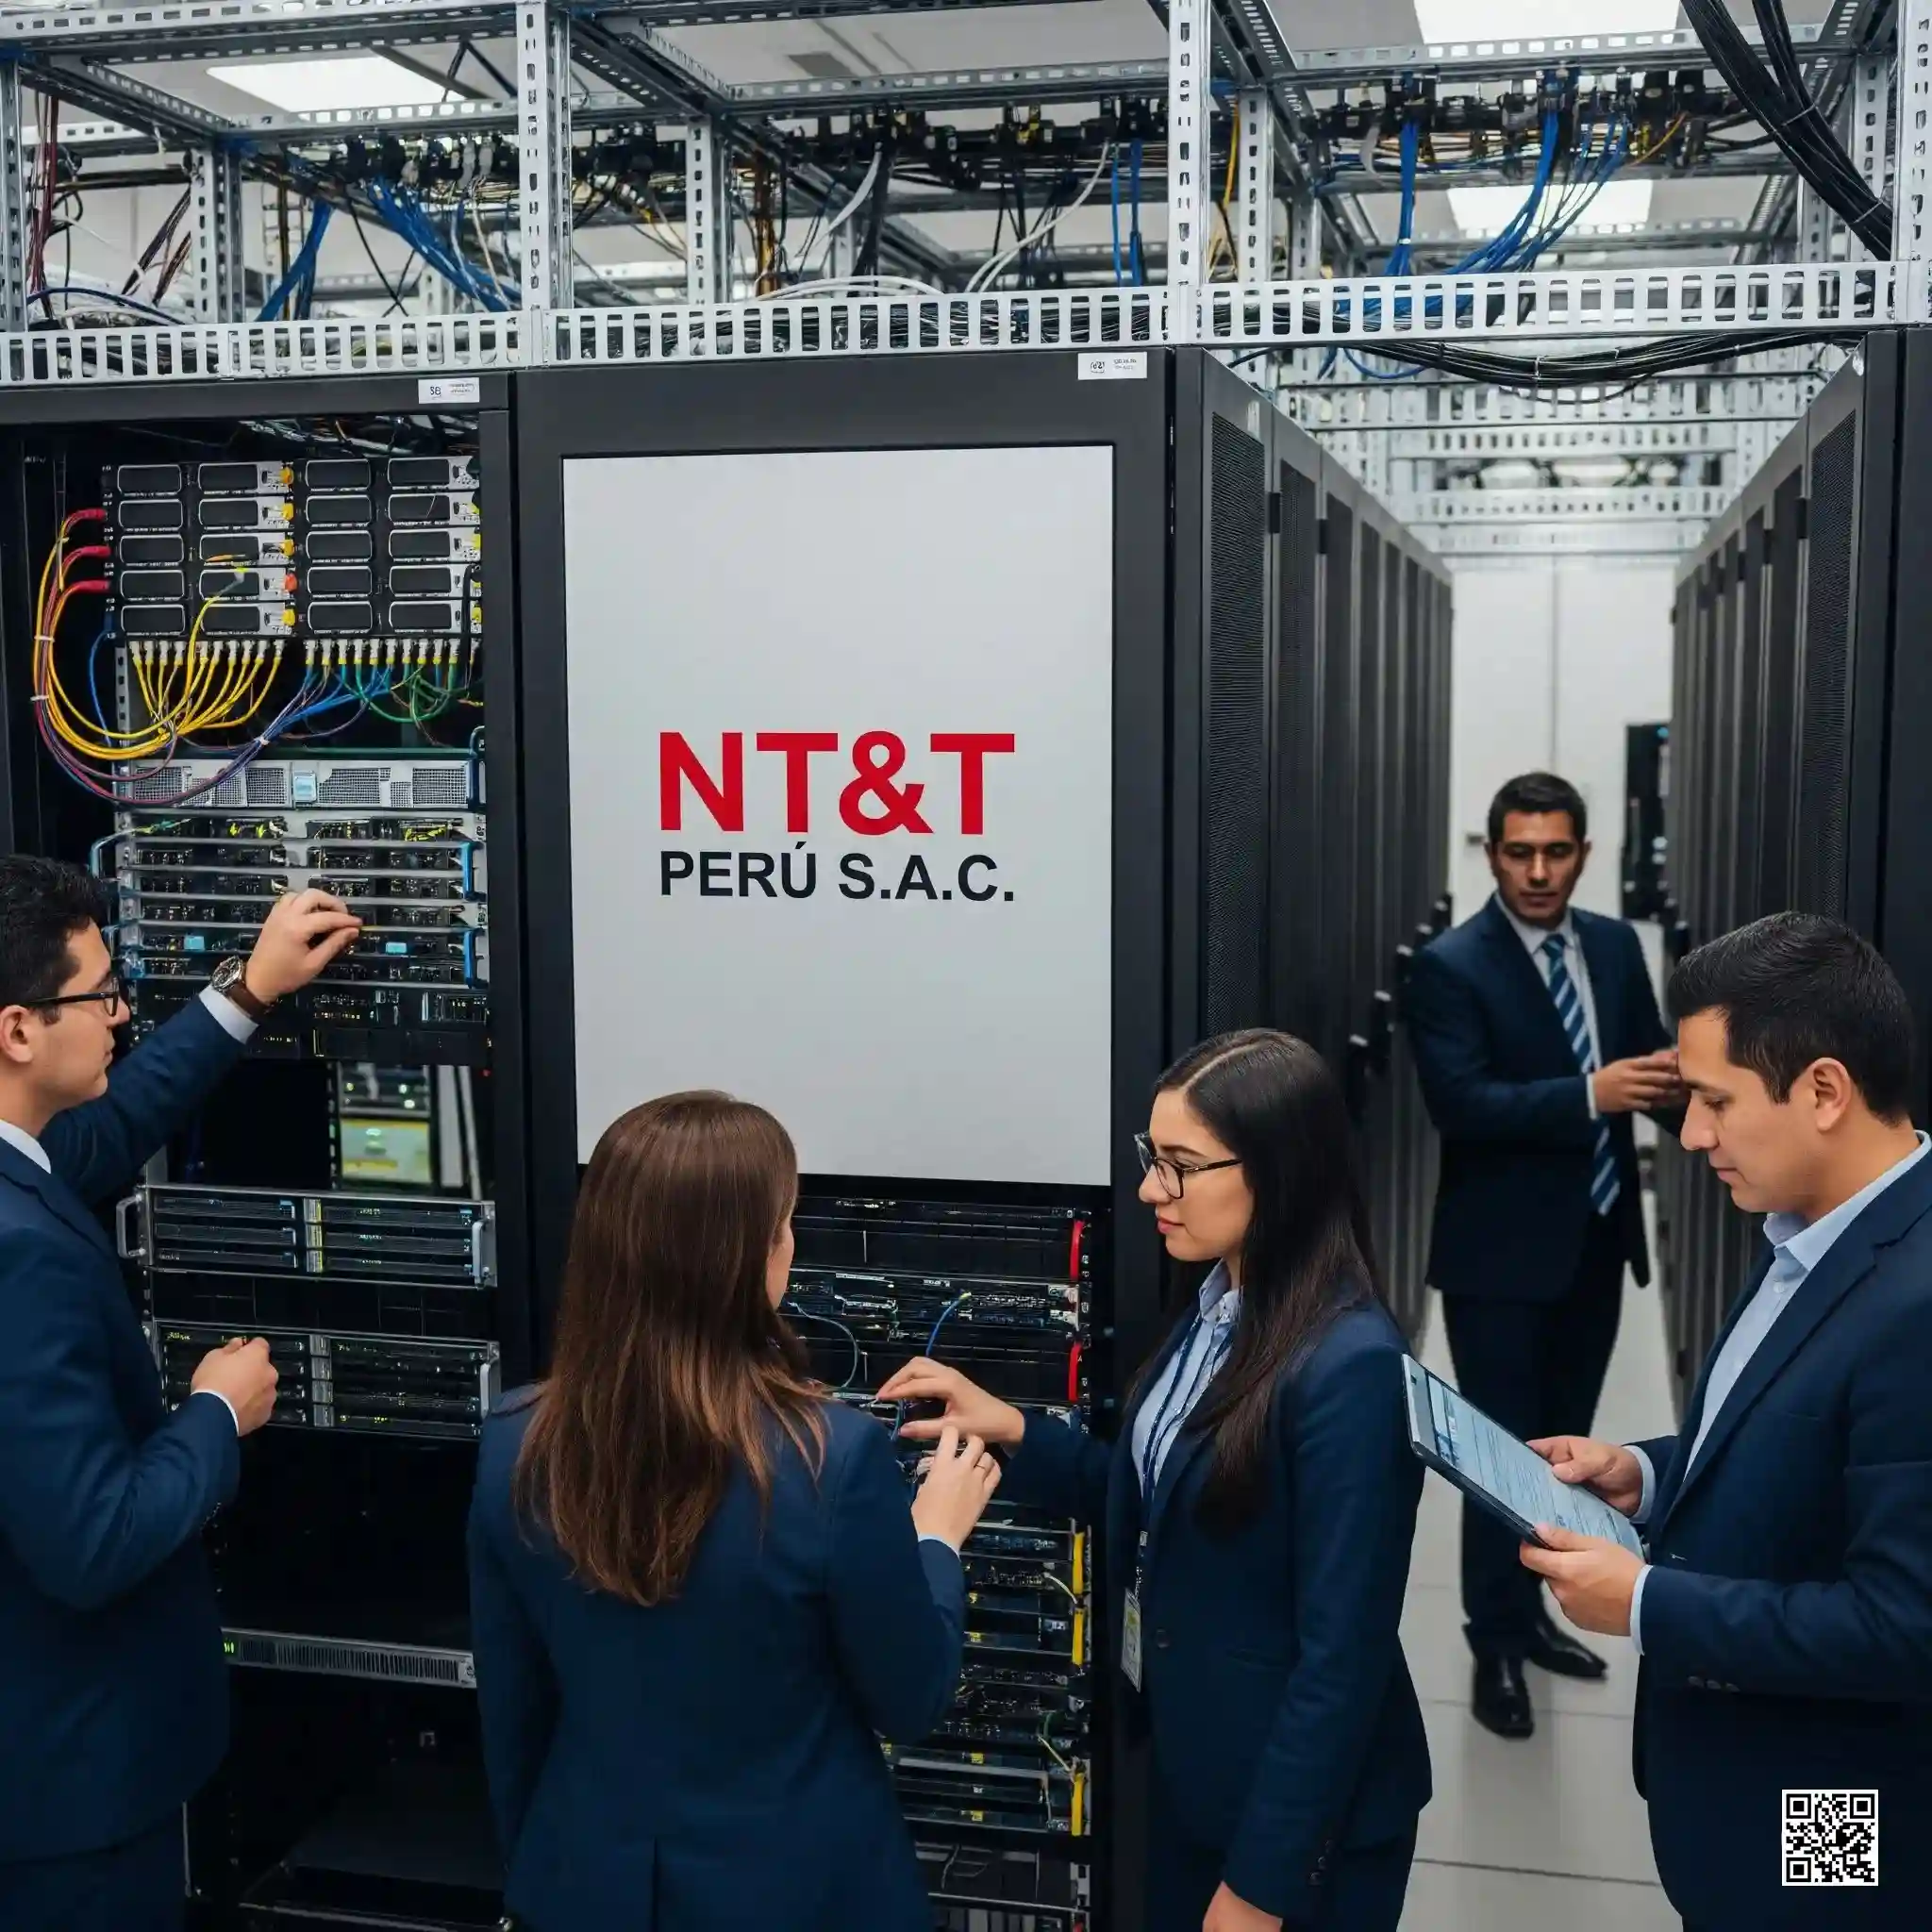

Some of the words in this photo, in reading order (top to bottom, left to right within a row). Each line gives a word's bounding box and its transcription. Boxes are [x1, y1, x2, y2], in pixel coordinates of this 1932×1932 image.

[660, 730, 1015, 836] NT&T
[660, 841, 817, 900] PERÚ
[838, 853, 1015, 902] S.A.C.
